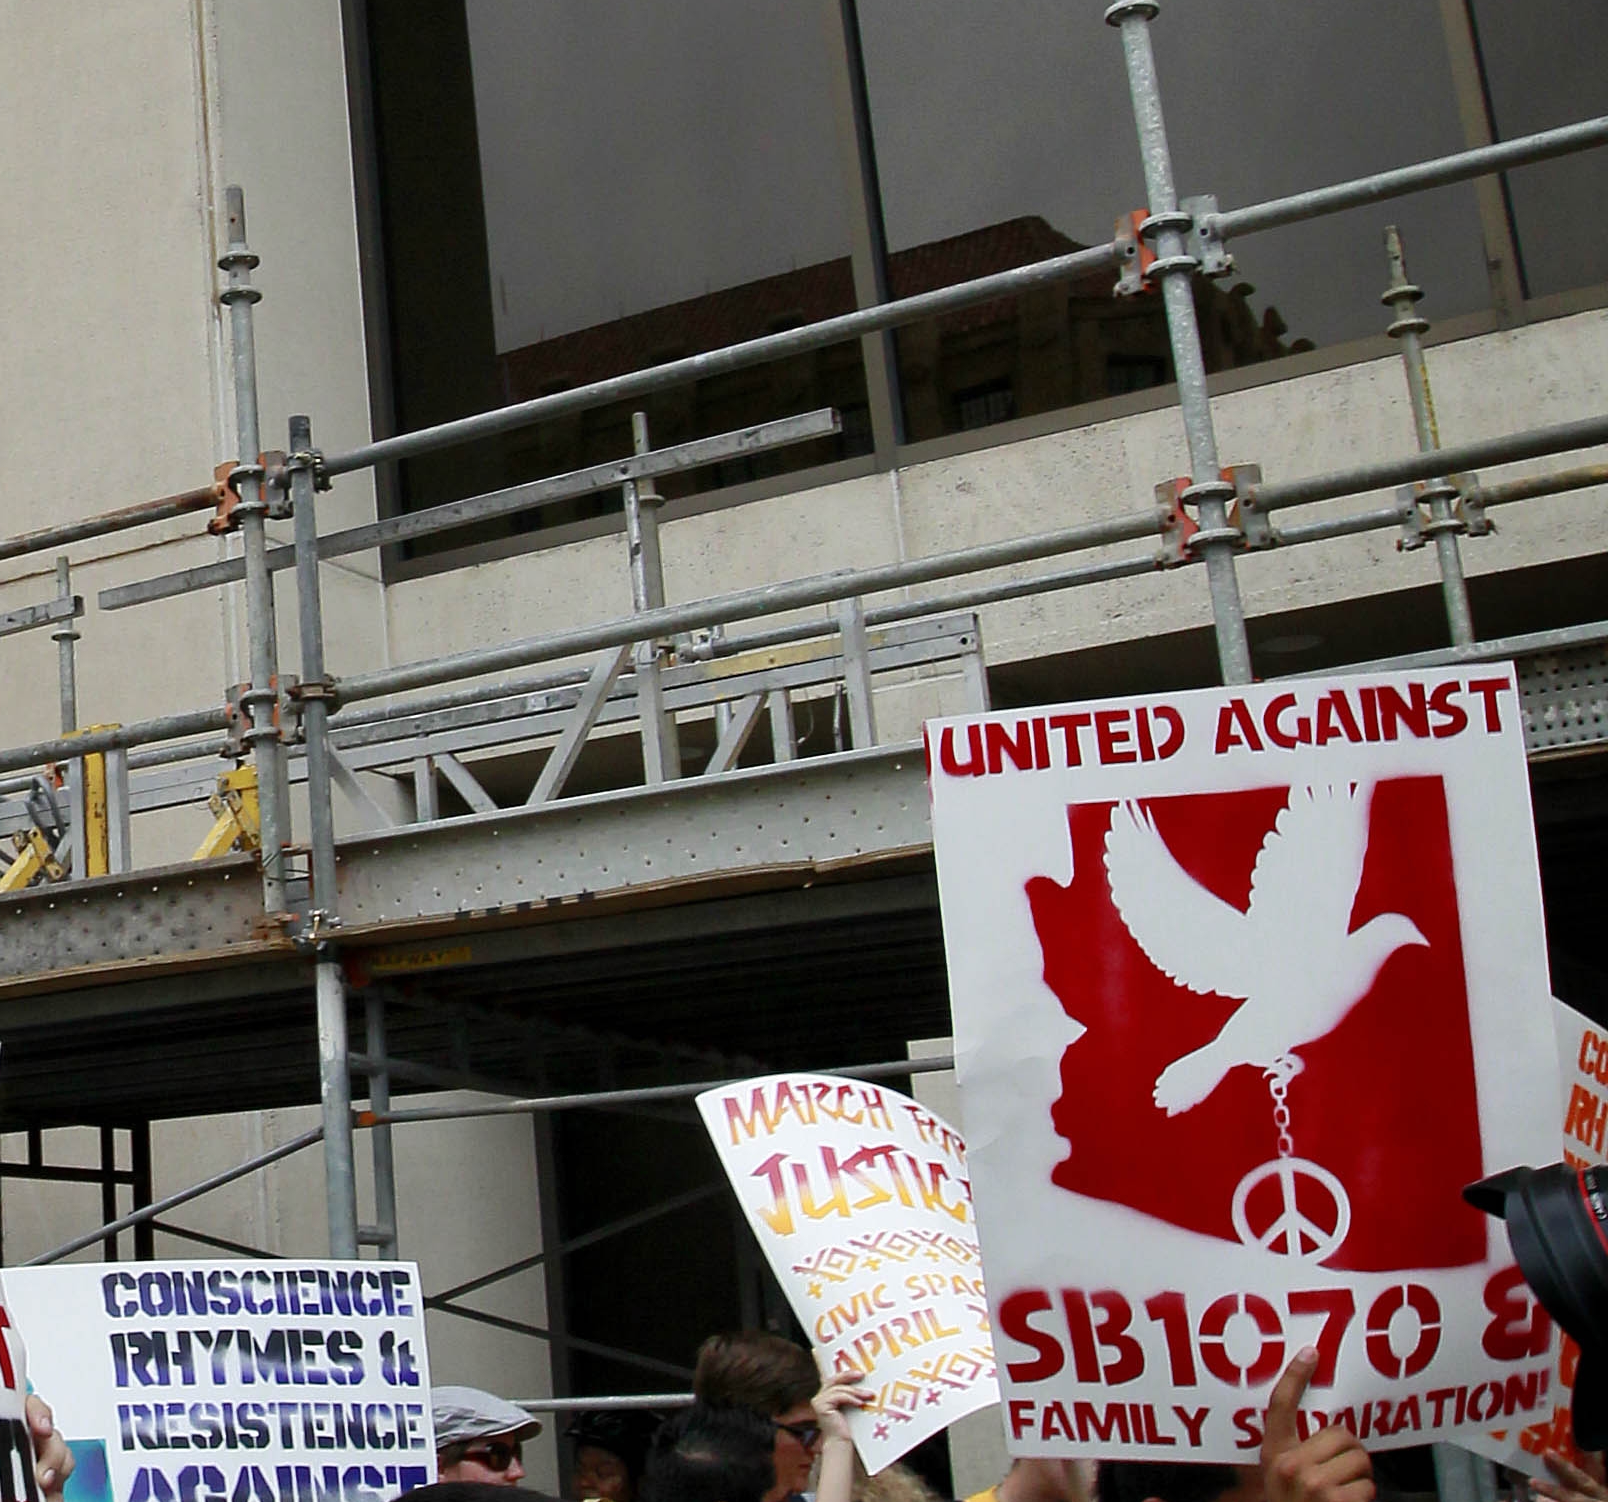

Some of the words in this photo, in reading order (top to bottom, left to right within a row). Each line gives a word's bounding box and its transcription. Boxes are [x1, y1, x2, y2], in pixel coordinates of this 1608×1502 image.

[939, 706, 1185, 778] UNITED
[1215, 677, 1511, 755] AGAINST
[723, 1081, 894, 1146] MARCH
[102, 1270, 414, 1317] CONSCIENCE
[815, 1283, 896, 1344] CIVIC
[998, 1283, 1441, 1388] SB1070
[1482, 1263, 1552, 1362] &
[110, 1329, 365, 1388] RHYMES
[380, 1330, 420, 1387] &
[832, 1308, 960, 1377] APRIL
[119, 1403, 425, 1450] RESISTENCE
[1008, 1400, 1211, 1449] FAMILY
[1232, 1368, 1550, 1450] SPARATION!
